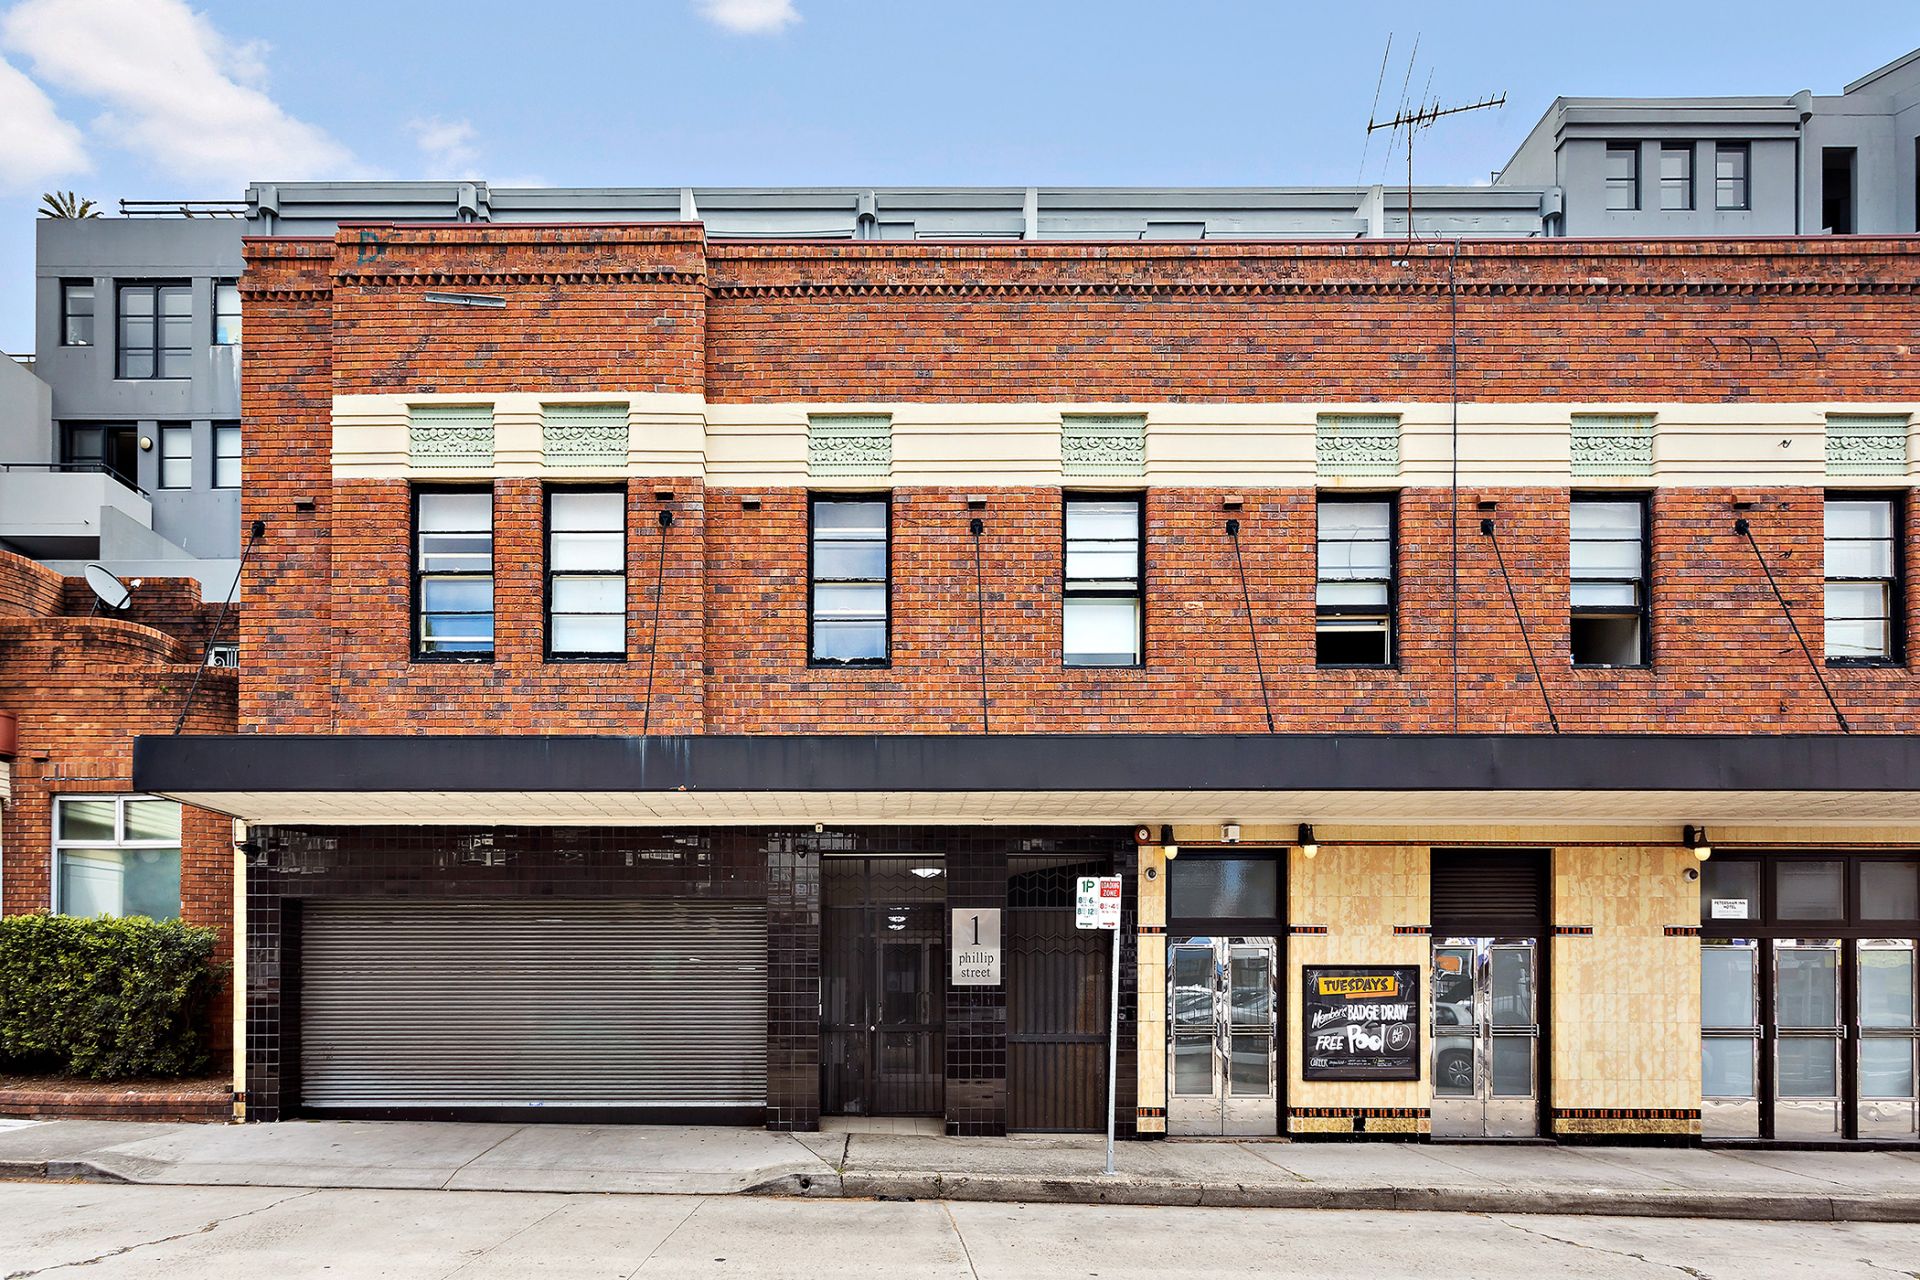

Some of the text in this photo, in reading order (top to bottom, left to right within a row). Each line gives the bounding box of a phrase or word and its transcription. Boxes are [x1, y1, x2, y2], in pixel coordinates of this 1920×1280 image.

[1082, 879, 1095, 893] 1P
[970, 915, 981, 946] 1
[959, 952, 994, 966] phillip
[961, 968, 990, 978] street
[1324, 977, 1388, 992] TUESDAYS
[1347, 1004, 1380, 1021] BADGE
[1380, 1004, 1409, 1021] DRAW
[1315, 1035, 1345, 1050] FREE
